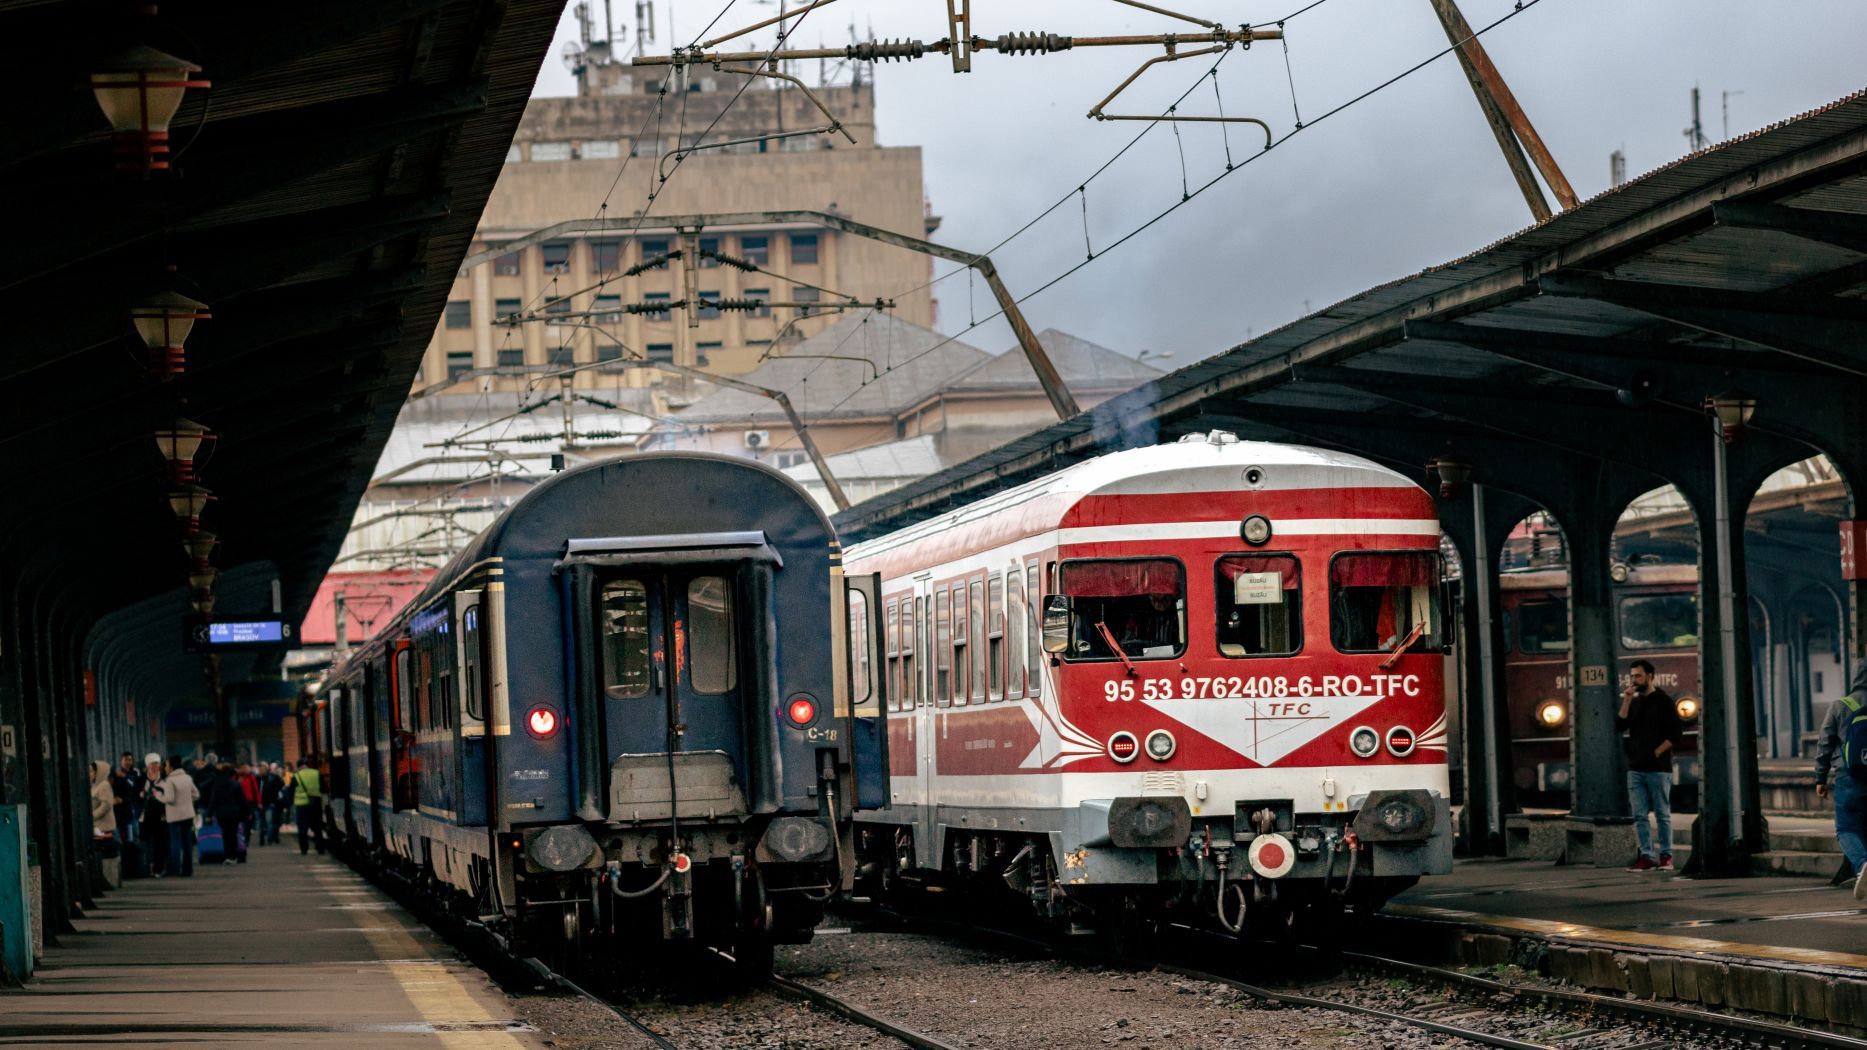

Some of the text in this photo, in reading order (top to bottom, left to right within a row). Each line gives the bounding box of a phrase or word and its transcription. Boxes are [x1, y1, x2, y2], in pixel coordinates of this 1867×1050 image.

[282, 623, 291, 638] 6
[1584, 669, 1604, 681] 134
[1104, 674, 1420, 703] 95 53 9762408-6-RO-TFC
[1268, 702, 1311, 716] TFC
[807, 727, 838, 741] C-18
